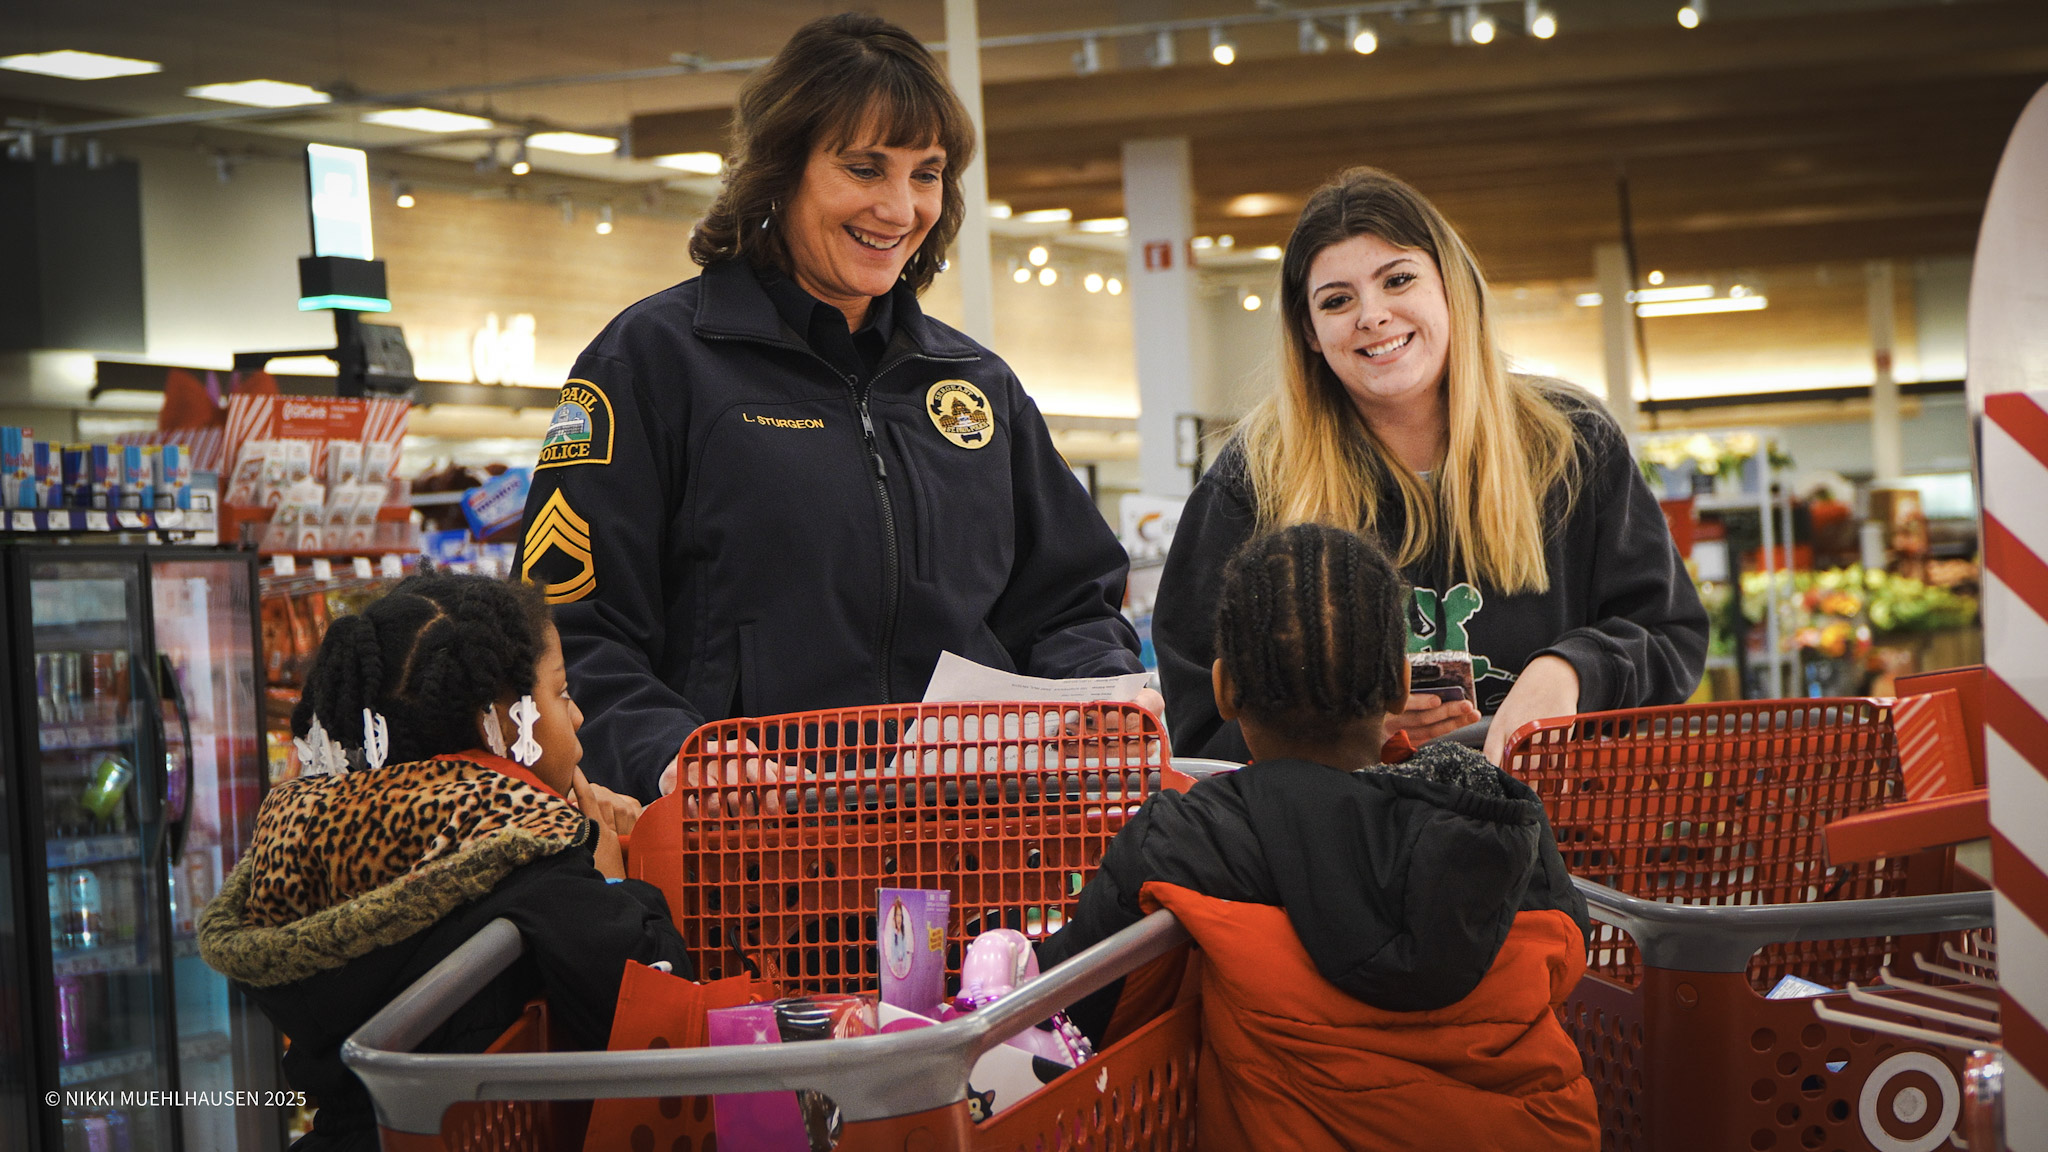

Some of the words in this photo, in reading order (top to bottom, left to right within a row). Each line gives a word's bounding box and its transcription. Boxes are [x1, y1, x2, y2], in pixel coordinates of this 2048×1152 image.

[560, 387, 597, 412] PAUL
[742, 412, 756, 423] L.
[756, 415, 825, 429] STURGEON
